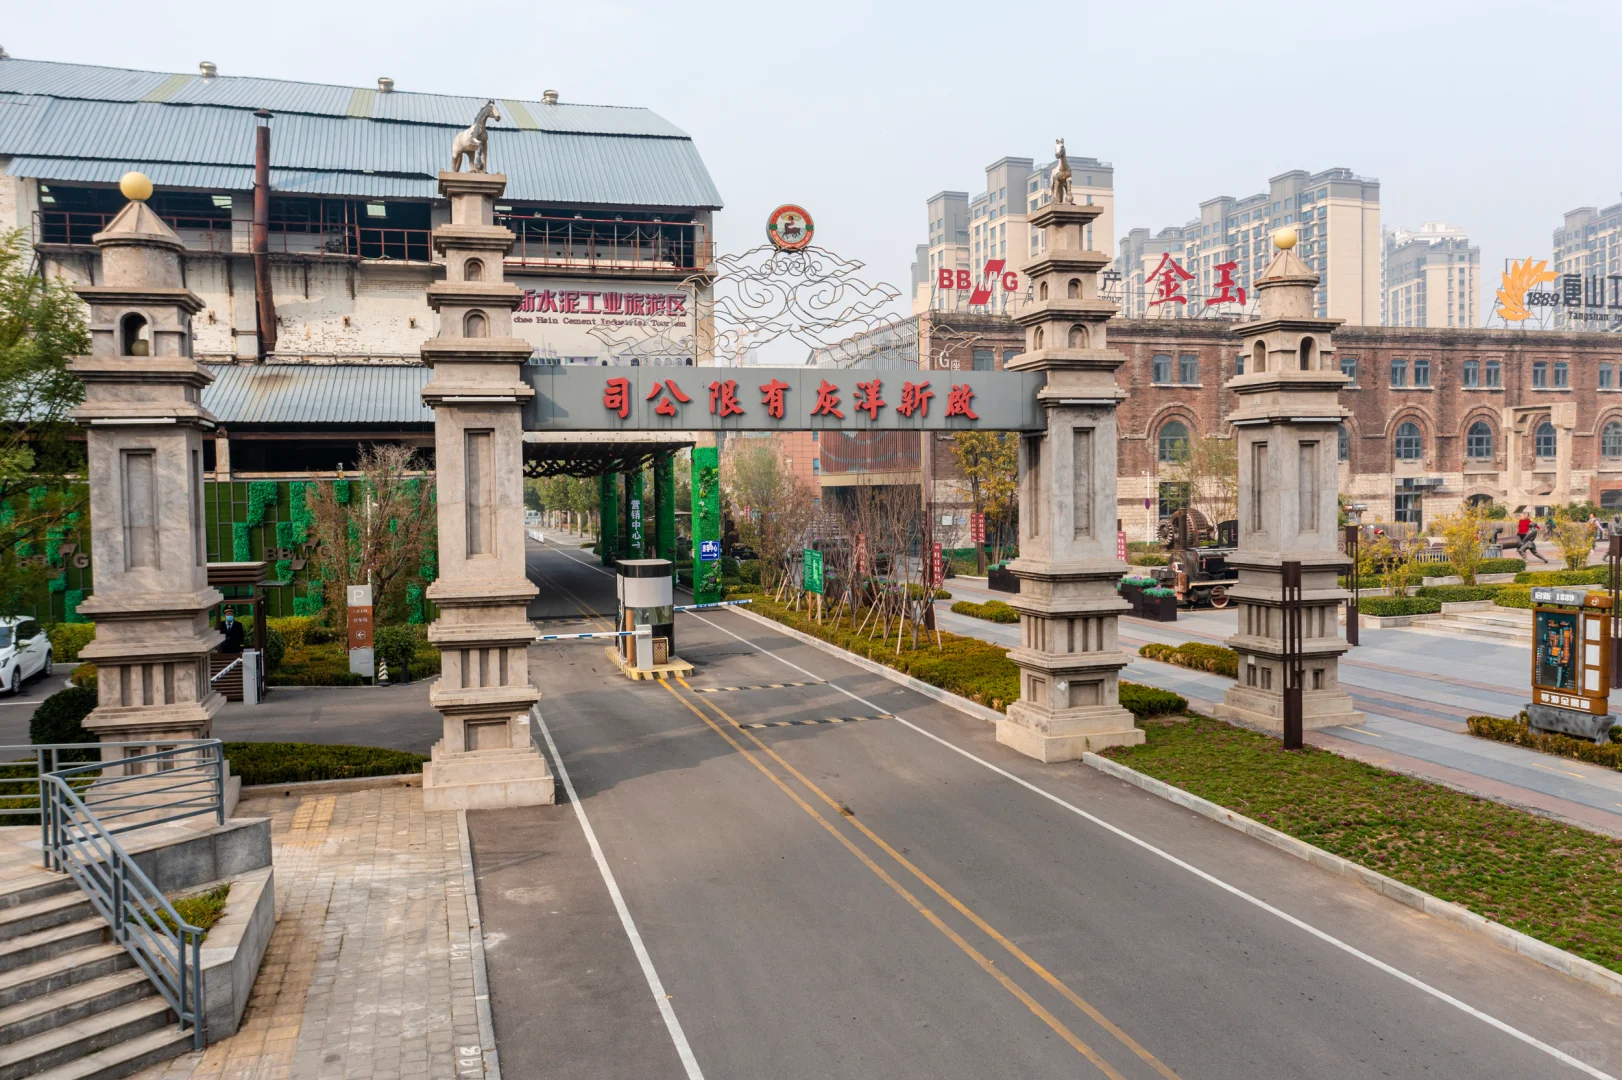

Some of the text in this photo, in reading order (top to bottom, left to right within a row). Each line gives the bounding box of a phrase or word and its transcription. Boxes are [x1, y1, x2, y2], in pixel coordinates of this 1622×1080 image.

[939, 259, 1018, 305] BBMG
[1143, 252, 1289, 306] 金玉
[1526, 291, 1560, 307] 1889
[563, 317, 596, 326] Cement
[1568, 311, 1609, 322] Tangshan
[631, 500, 641, 540] 营销中心
[353, 589, 364, 603] P
[1556, 593, 1575, 602] 1889
